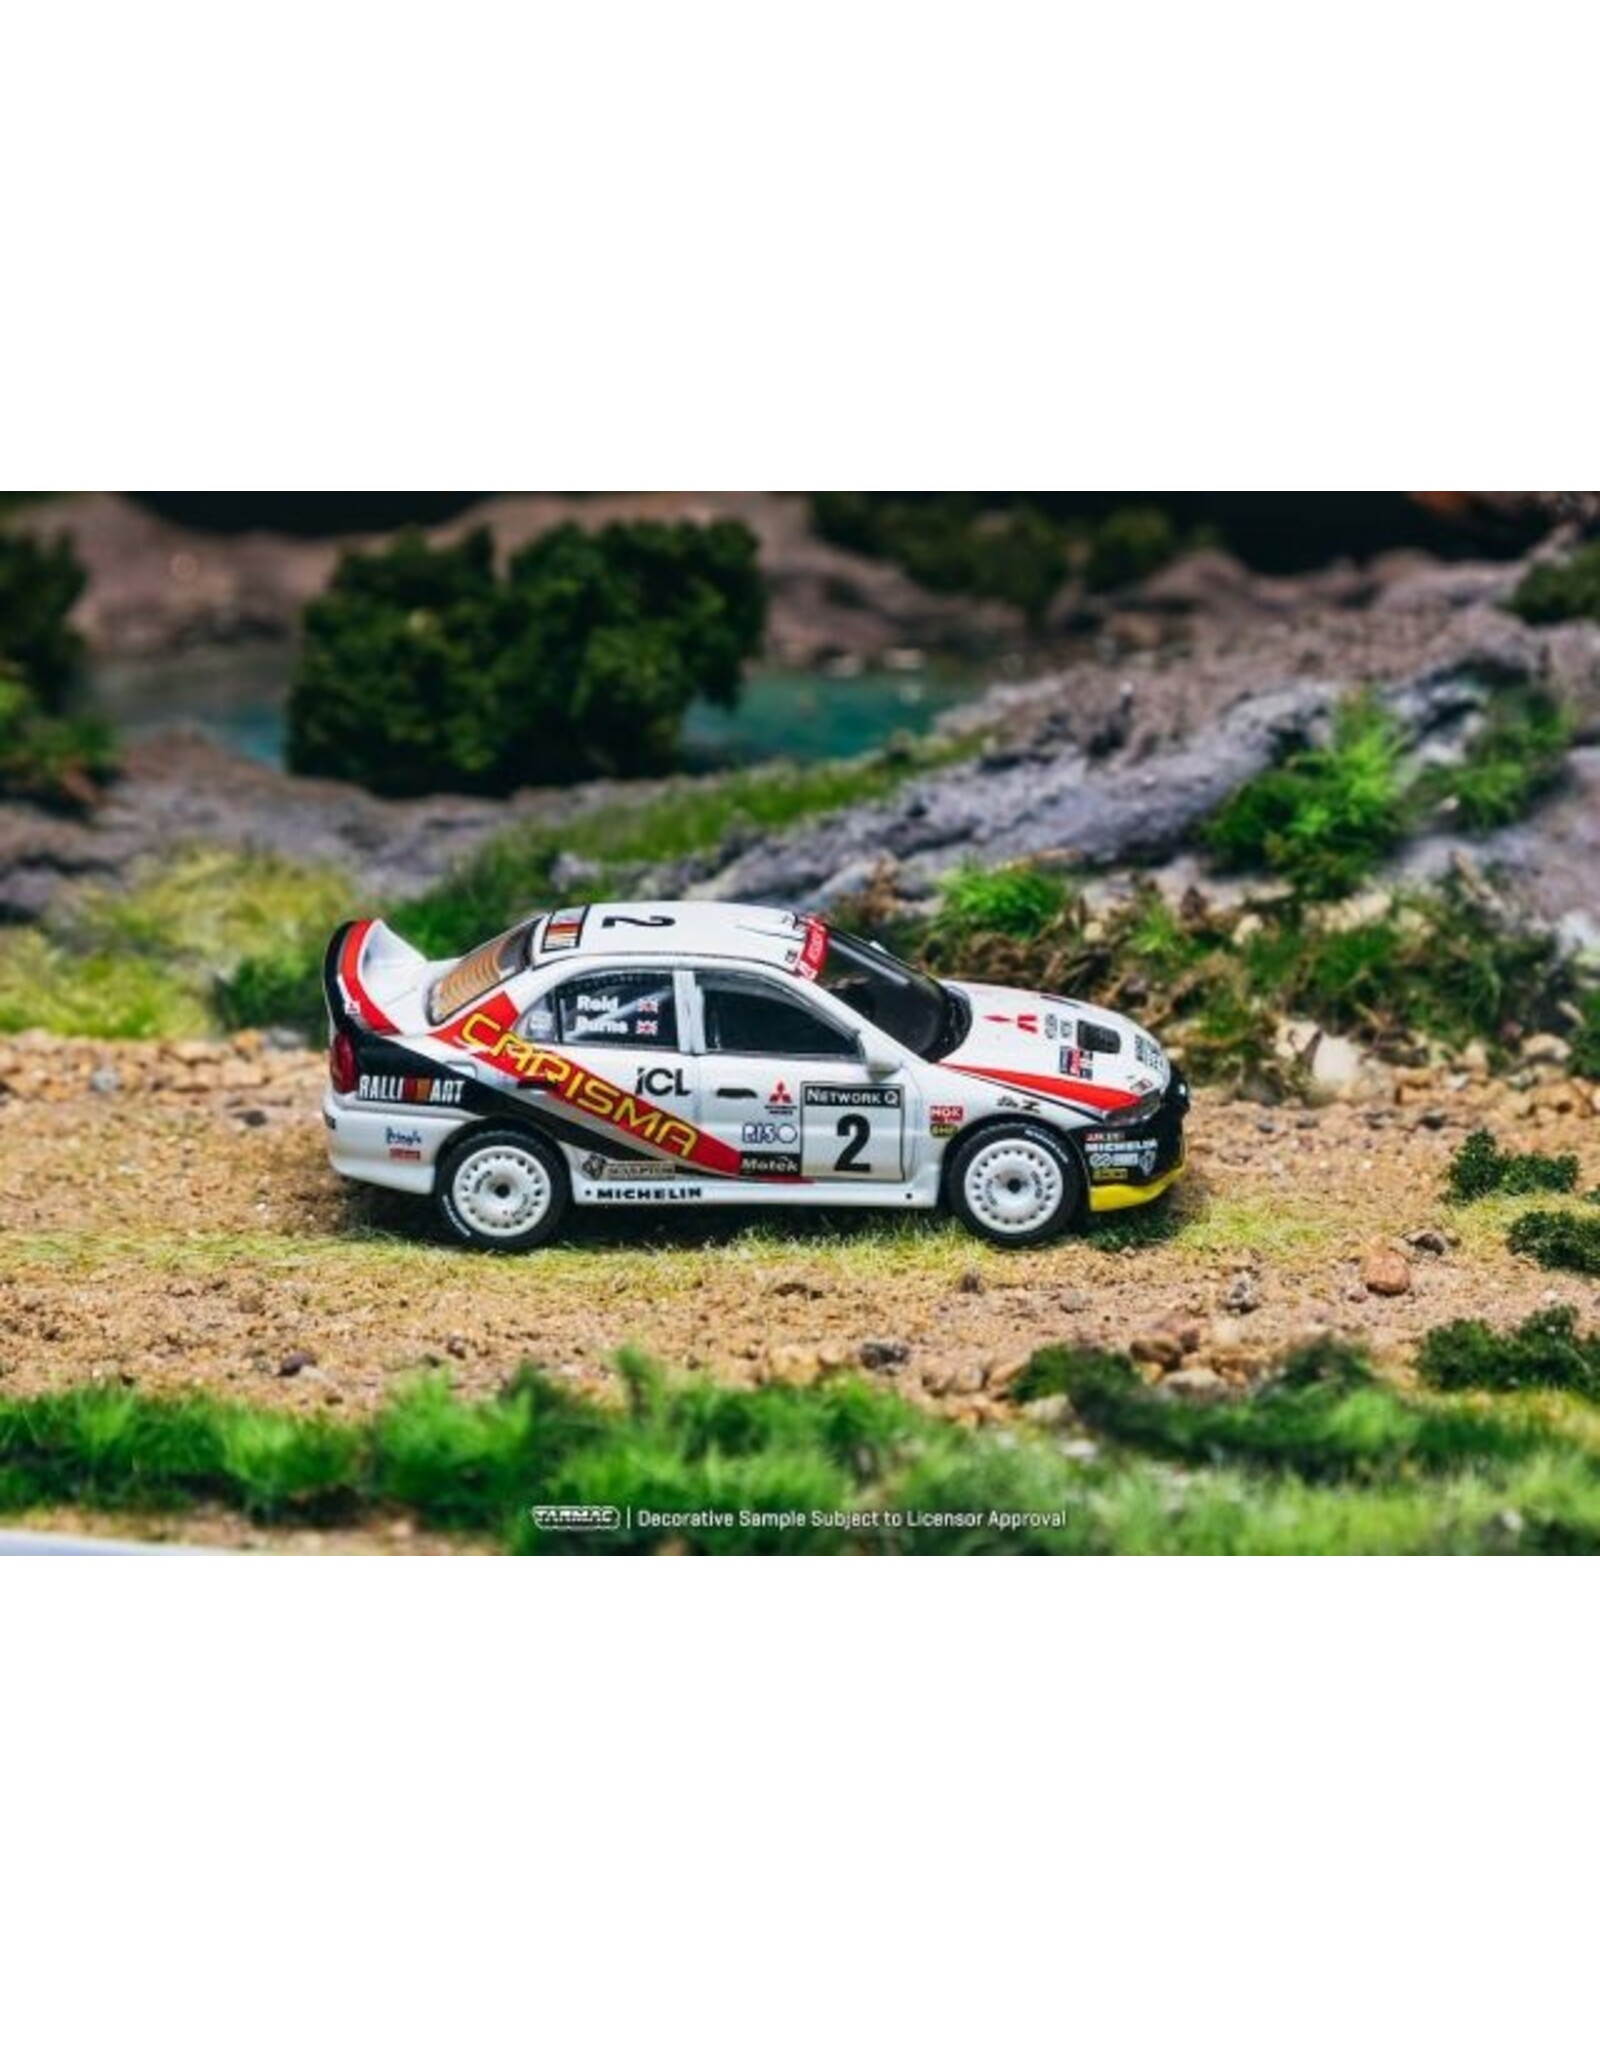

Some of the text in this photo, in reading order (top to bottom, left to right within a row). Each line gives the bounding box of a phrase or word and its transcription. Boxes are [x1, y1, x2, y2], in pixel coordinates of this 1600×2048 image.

[602, 915, 676, 929] 2
[576, 995, 618, 1012] Reid
[359, 1074, 466, 1103] RALLI ART
[461, 1012, 698, 1157] CARISMA
[884, 1090, 899, 1106] Q
[834, 1113, 871, 1172] 2
[597, 1187, 702, 1199] MICHELIN
